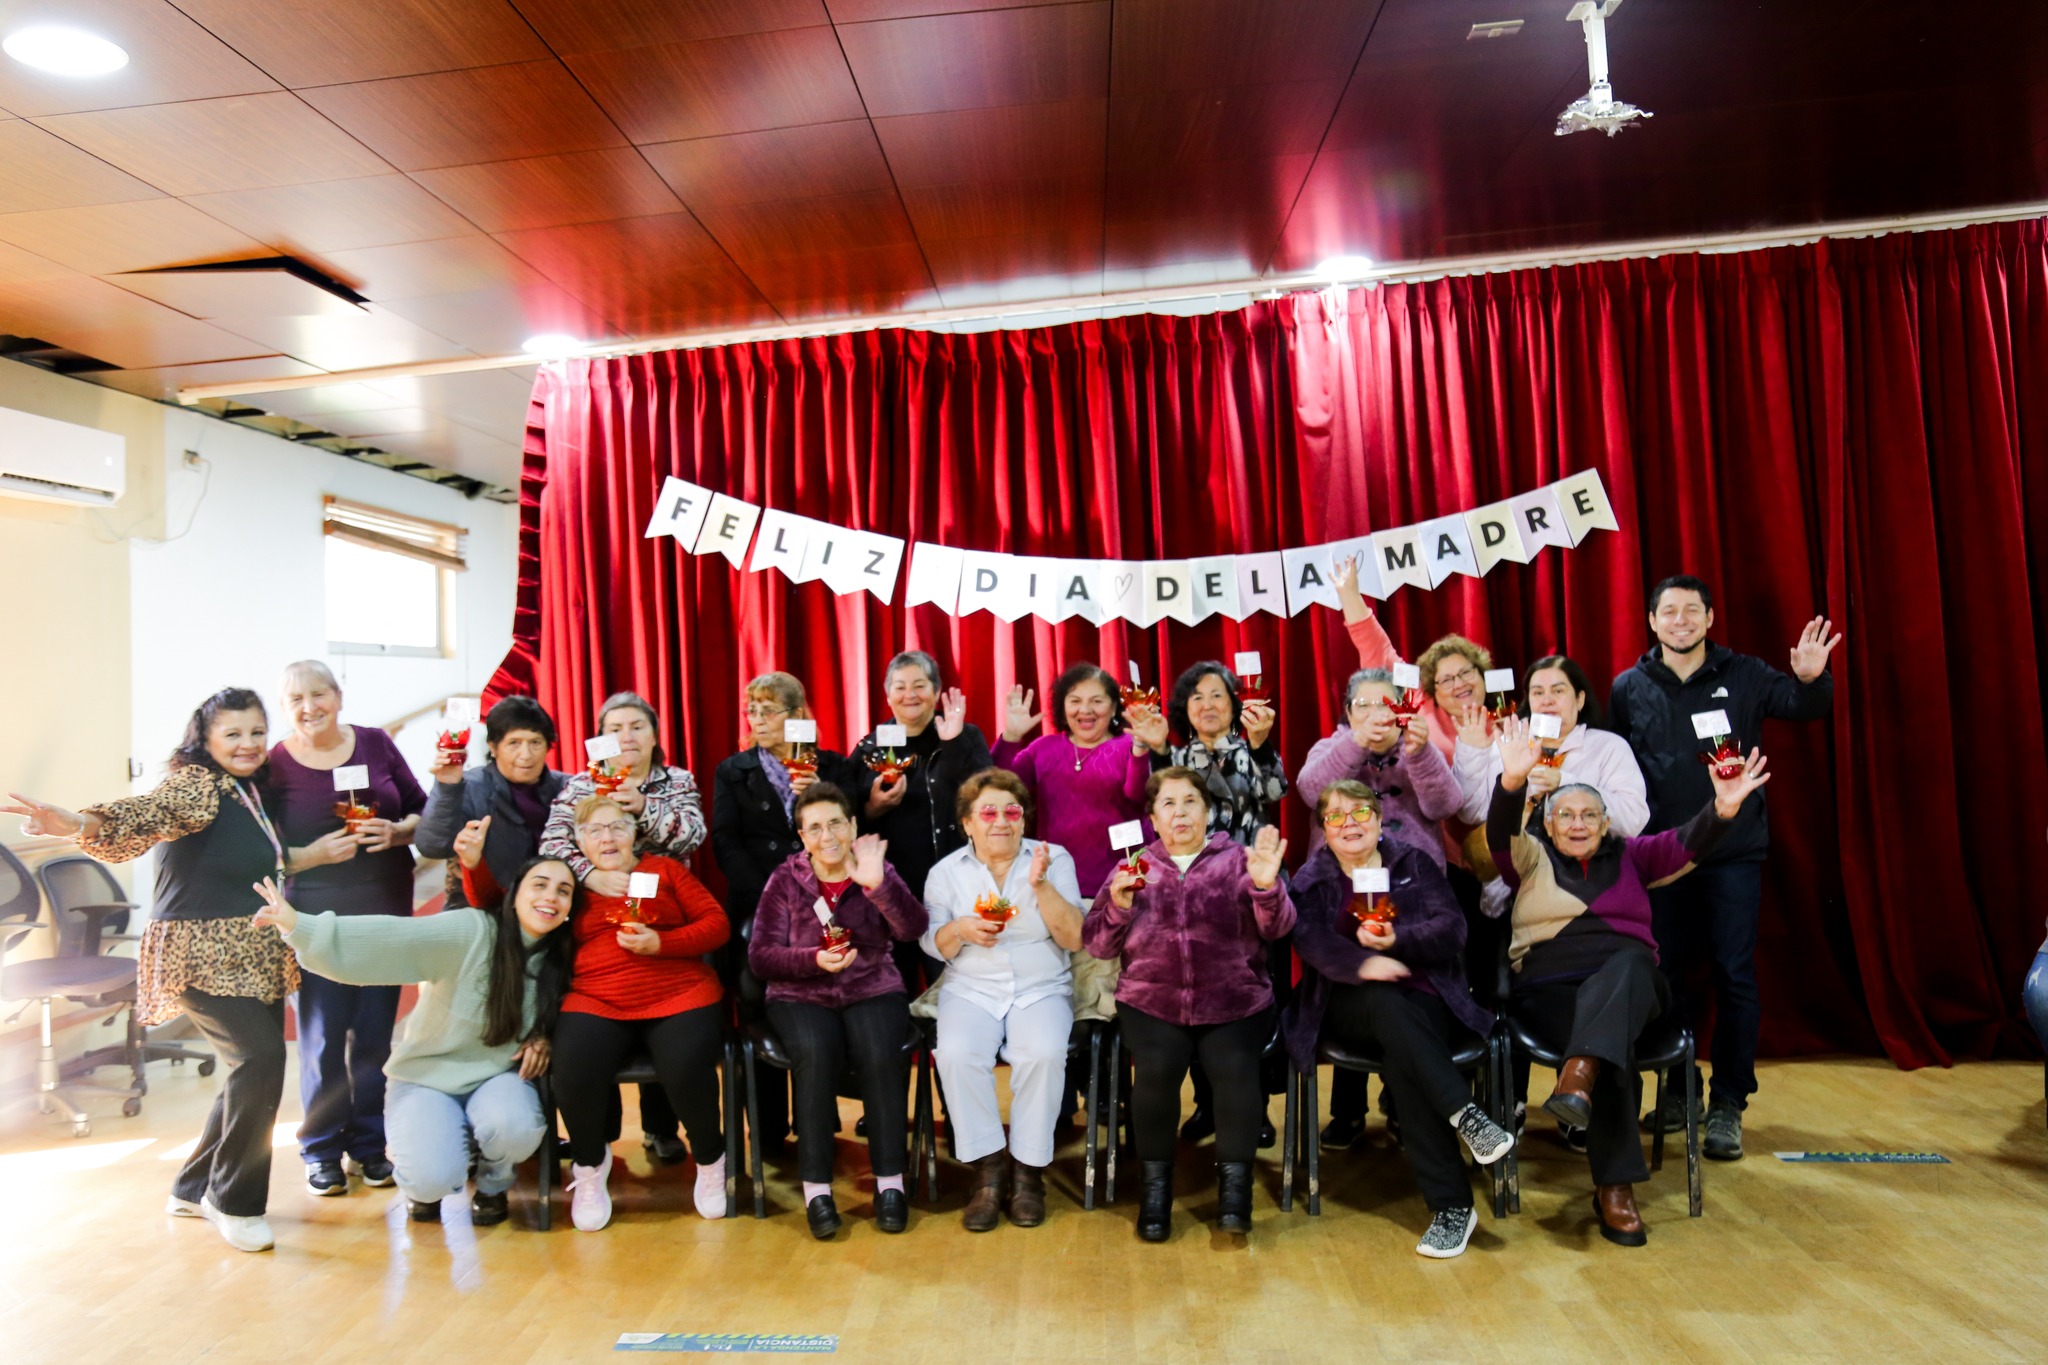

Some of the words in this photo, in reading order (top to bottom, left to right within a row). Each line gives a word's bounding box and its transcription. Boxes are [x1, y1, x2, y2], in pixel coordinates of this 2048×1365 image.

[670, 497, 886, 576] FELIZ
[976, 568, 1090, 600] DIA
[1385, 489, 1594, 572] MADRE
